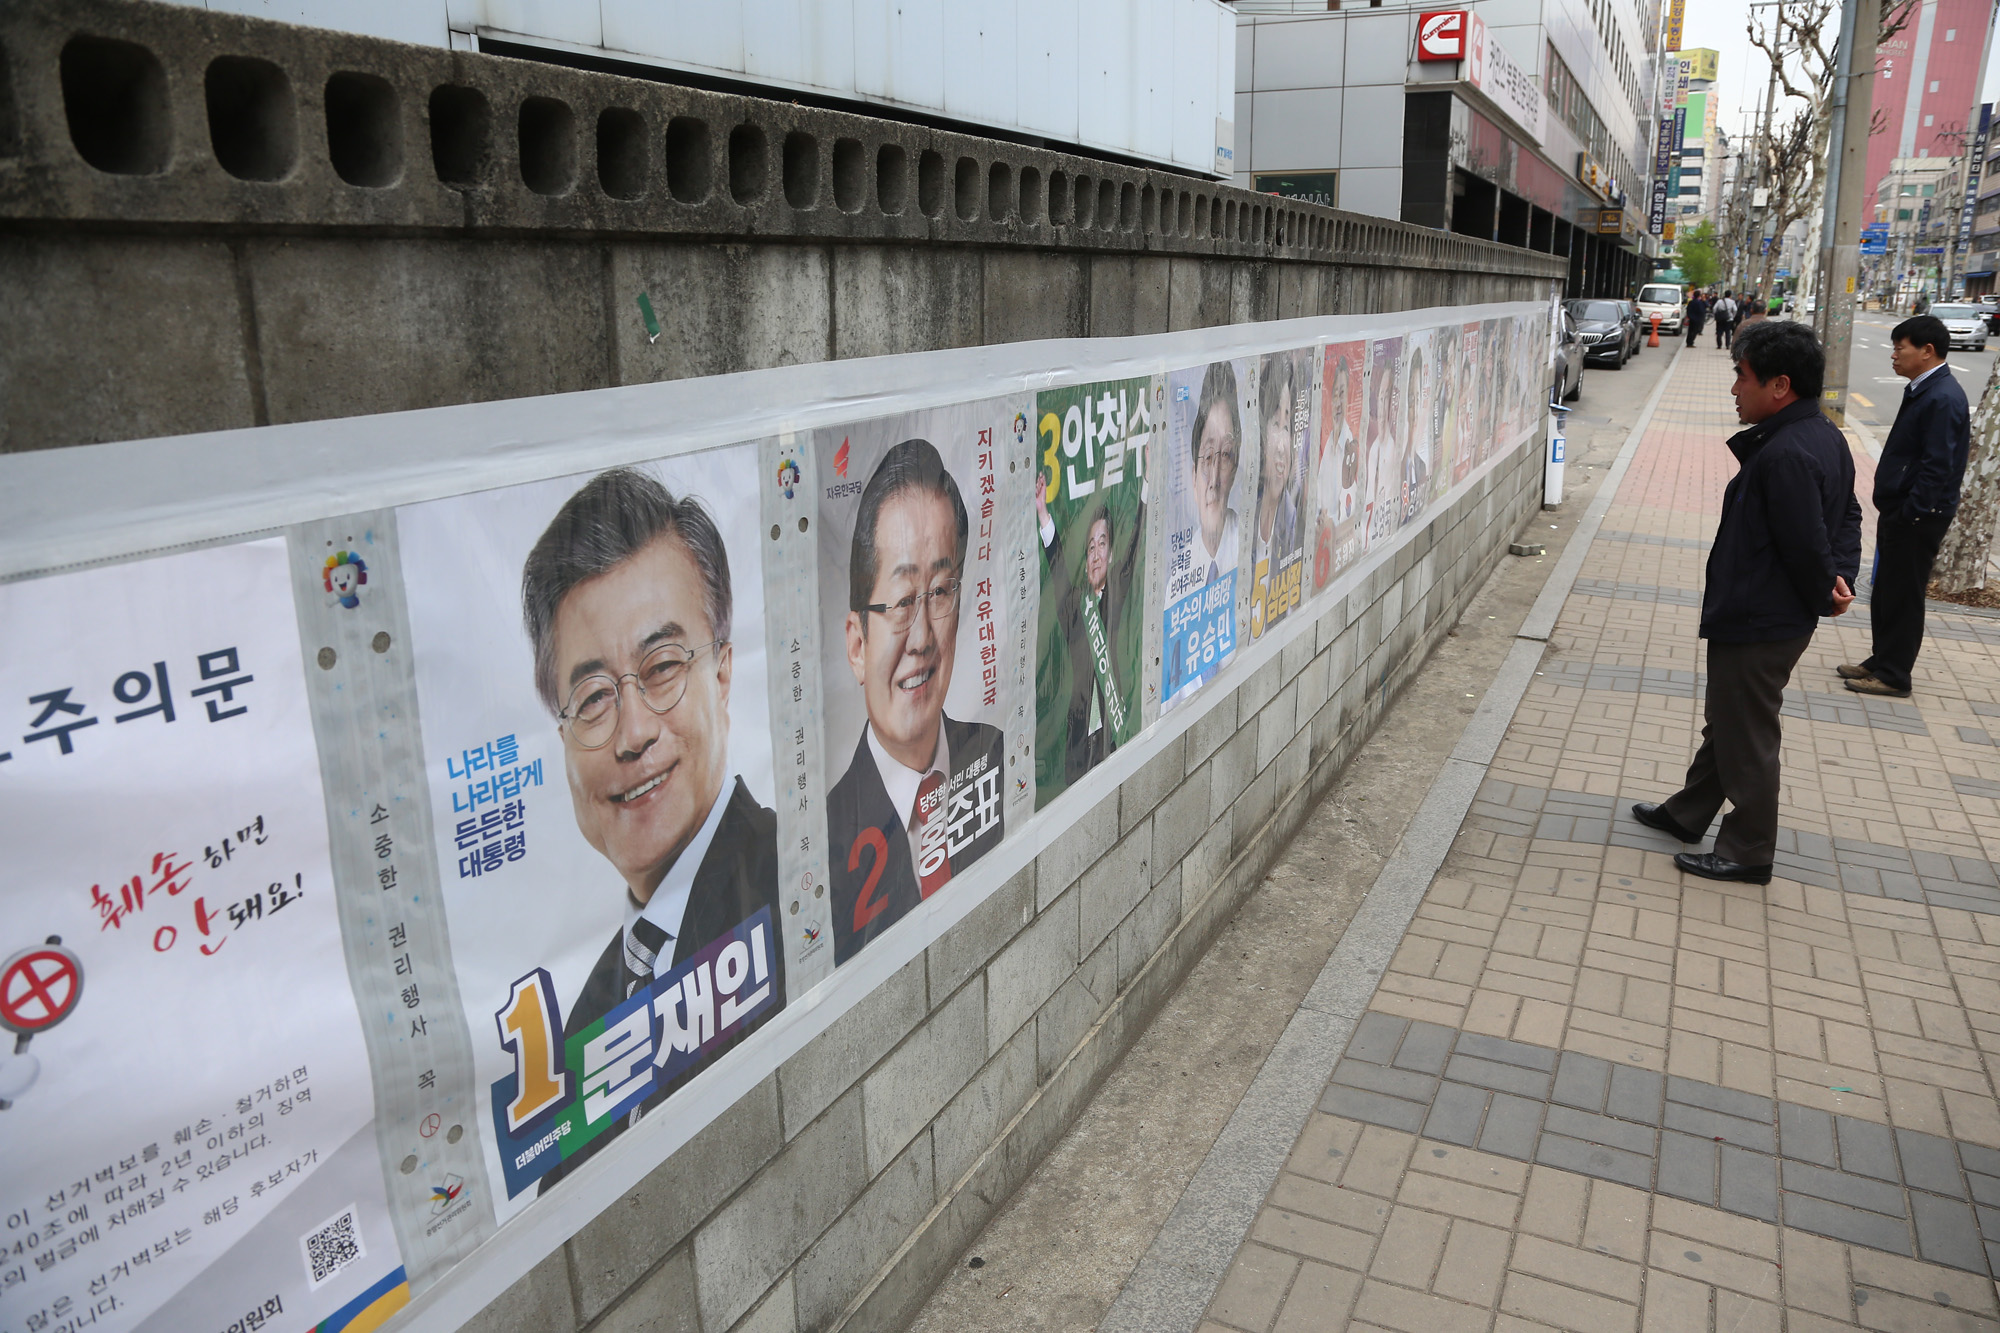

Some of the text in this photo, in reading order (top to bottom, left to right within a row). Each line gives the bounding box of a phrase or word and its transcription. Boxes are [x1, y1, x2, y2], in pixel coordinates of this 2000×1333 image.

[1422, 15, 1457, 41] Cummins
[1678, 61, 1691, 89] 인쇄
[1651, 192, 1665, 234] 한국산업
[1039, 412, 1061, 504] 3
[1062, 388, 1150, 500] 안철수
[826, 480, 862, 499] 자유한국당
[976, 427, 997, 706] 지키겠습니다 자유대한민국
[1171, 526, 1193, 550] 당신의
[1171, 549, 1192, 577] 능력을
[1315, 527, 1331, 589] 6
[1018, 549, 1027, 600] 소중한
[1171, 564, 1205, 599] 보여주세요!
[1251, 558, 1302, 639] 5 심상정
[1170, 575, 1232, 638] 보수의 새희망
[1186, 608, 1231, 675] 유승민
[446, 734, 519, 779] 나라를
[789, 638, 811, 853] 소중한 권리행사 꼭
[452, 758, 543, 814] 나라답게
[920, 752, 988, 813] 당당한 서민 대통령
[454, 799, 525, 850] 든든한
[458, 831, 526, 878] 대통령
[847, 766, 1000, 933] 2 홍준표
[370, 803, 436, 1090] 소중한 권리행사 꼭
[496, 922, 771, 1138] 1 문재인
[104, 1173, 148, 1204] 따라
[161, 1149, 192, 1176] 2년
[206, 1112, 264, 1150] 이하의
[276, 1087, 312, 1116] 징역
[515, 1119, 573, 1170] 더불어민주당
[7, 1207, 30, 1230] 이
[44, 1142, 161, 1213] 선거벽보를
[34, 1225, 100, 1272] 벌금에
[107, 1188, 166, 1231] 처해질
[171, 1176, 191, 1194] 수
[196, 1132, 272, 1182] 있습니다.
[87, 1227, 193, 1297] 선거벽보는
[202, 1196, 240, 1226] 해당
[250, 1148, 319, 1199] 후보자가
